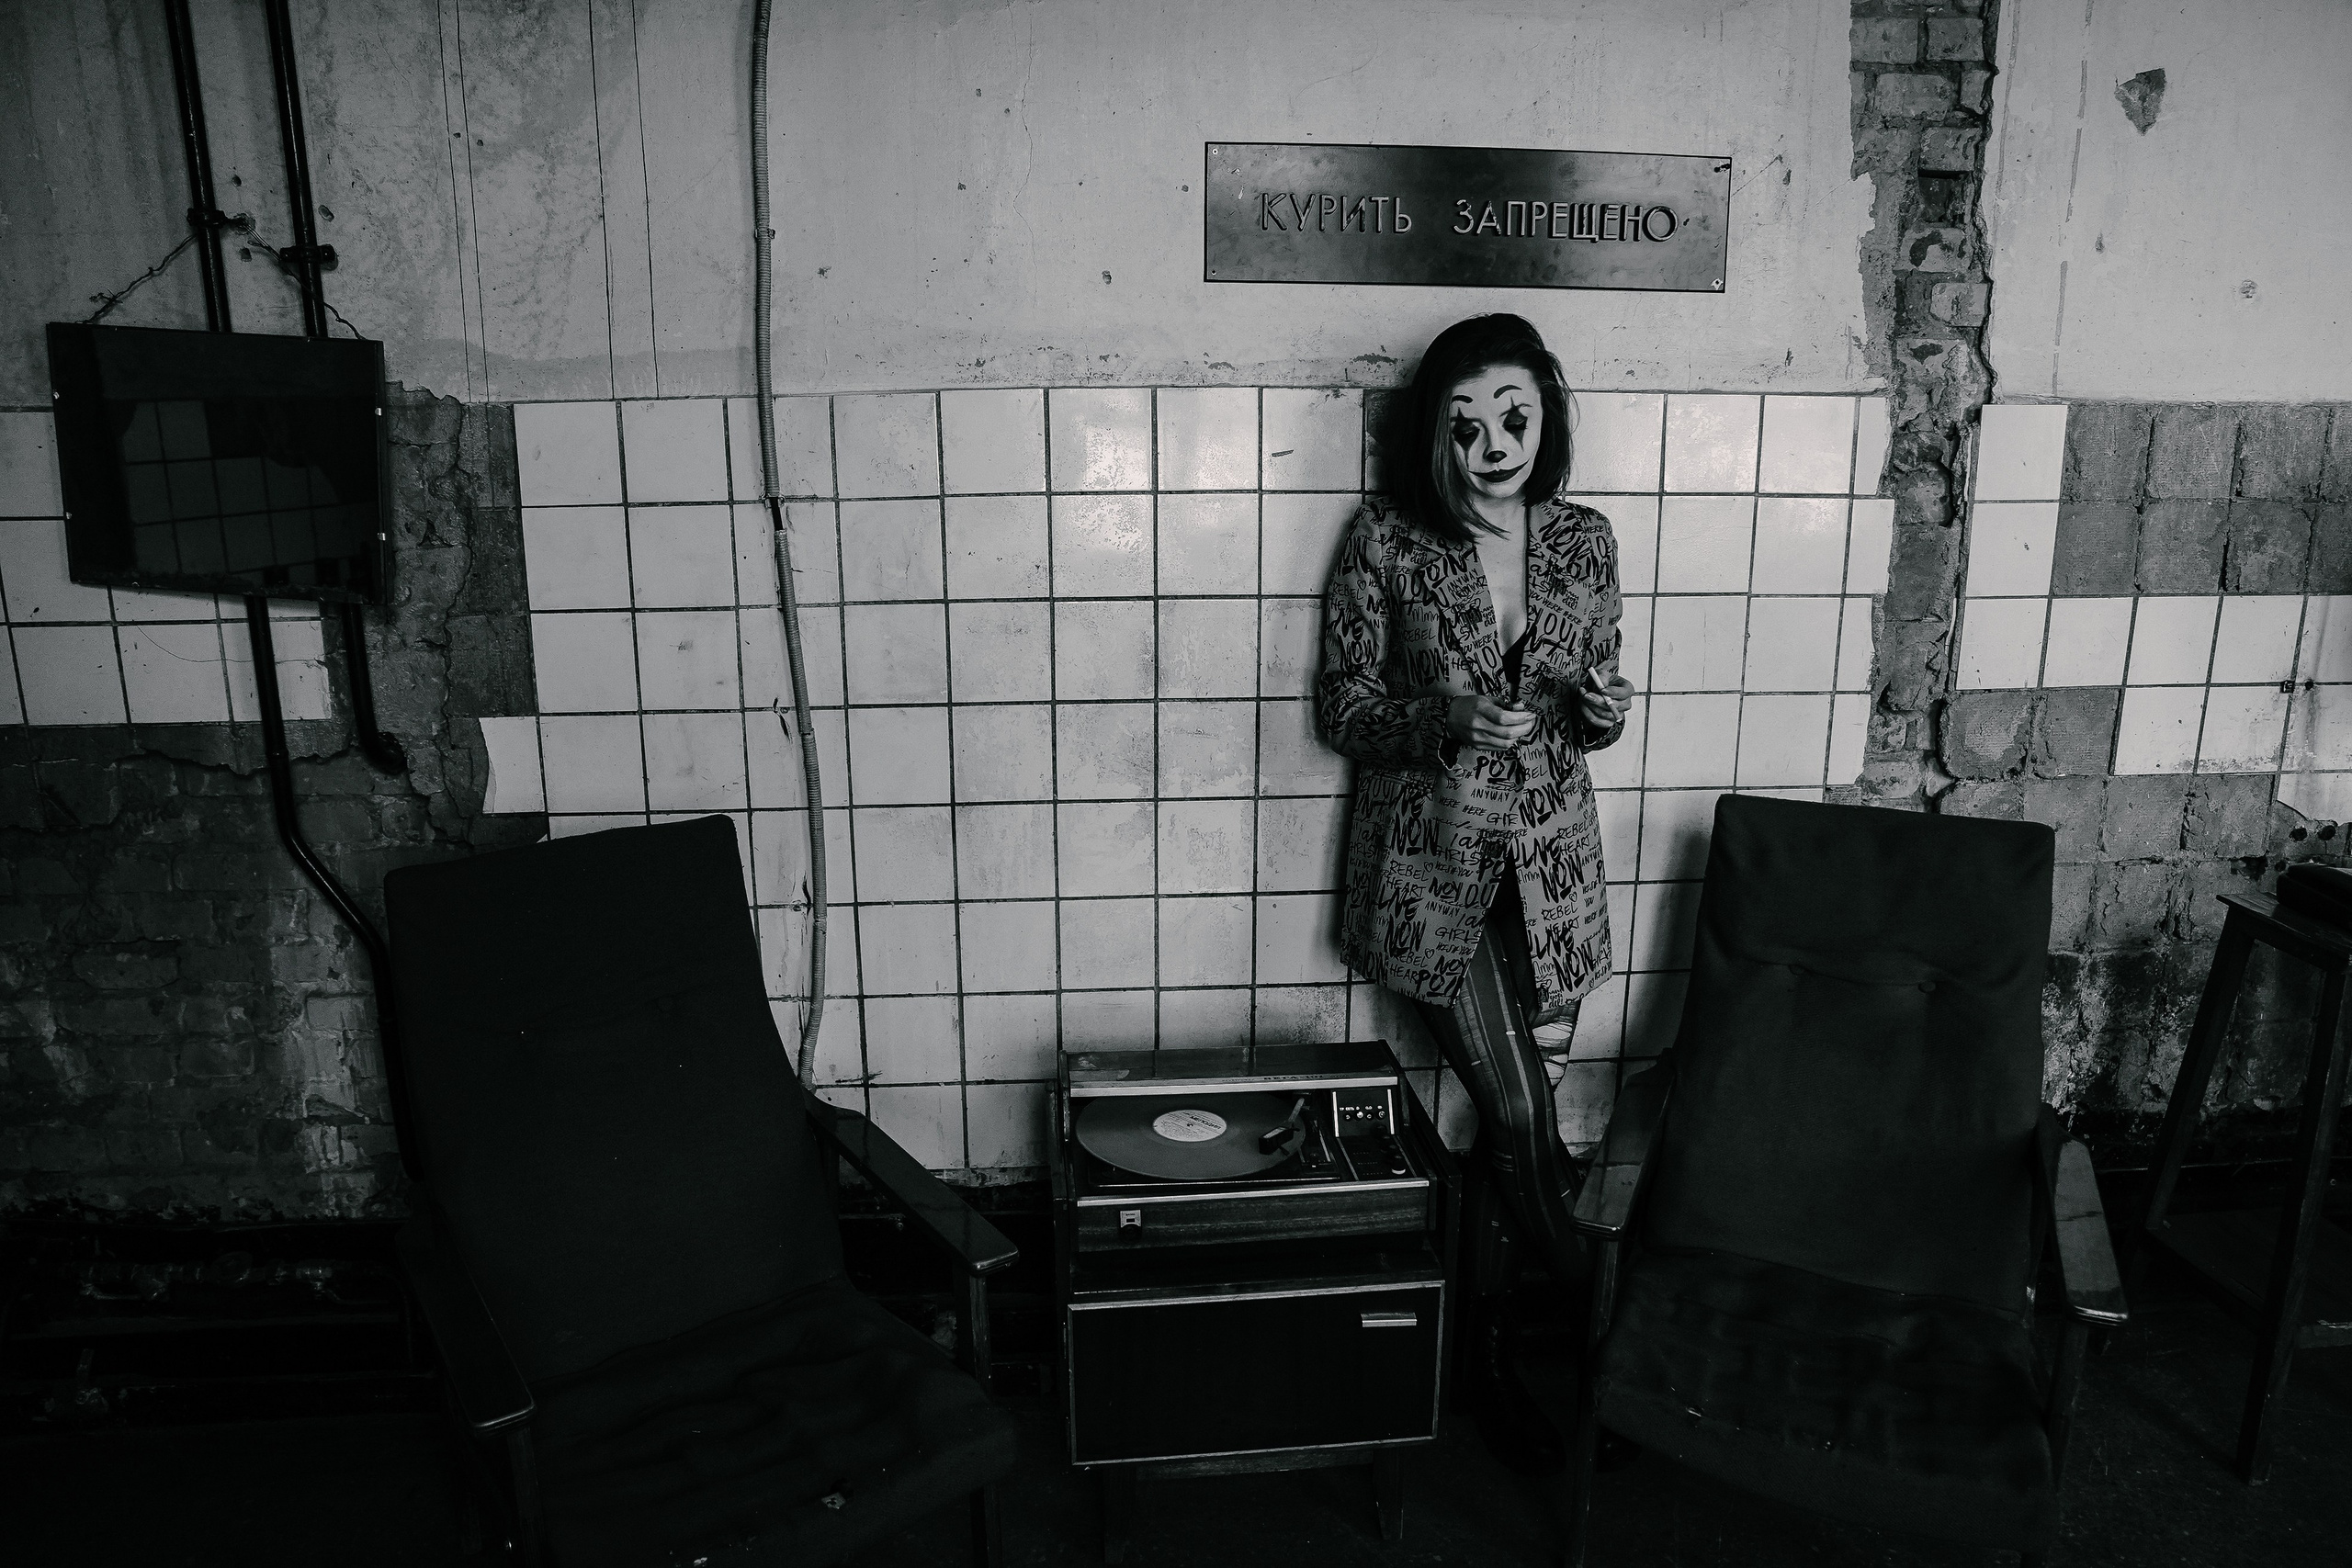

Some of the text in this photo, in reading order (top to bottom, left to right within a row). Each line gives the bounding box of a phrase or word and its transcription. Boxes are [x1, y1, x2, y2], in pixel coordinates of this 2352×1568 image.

[1261, 193, 1679, 243] КУРИТЬ ЗАПРЕЩЕНО
[1332, 582, 1364, 600] REBEL
[1543, 598, 1563, 613] WERE
[1403, 627, 1436, 642] REBEL
[1439, 795, 1461, 807] WERE
[1470, 788, 1510, 802] ANYWAY
[1556, 820, 1589, 840] REBEL
[1560, 833, 1590, 855] HEART
[1390, 860, 1429, 882] REBEL
[1538, 850, 1584, 903] NOW
[1386, 876, 1427, 897] HEART
[1424, 900, 1460, 917] ANYWAY
[1541, 901, 1577, 921] REBEL
[1384, 912, 1427, 953] NOW
[1545, 916, 1579, 934] HEART
[1435, 927, 1482, 944] GIRLS
[1390, 964, 1418, 984] HEAR
[1552, 937, 1594, 992] NOW
